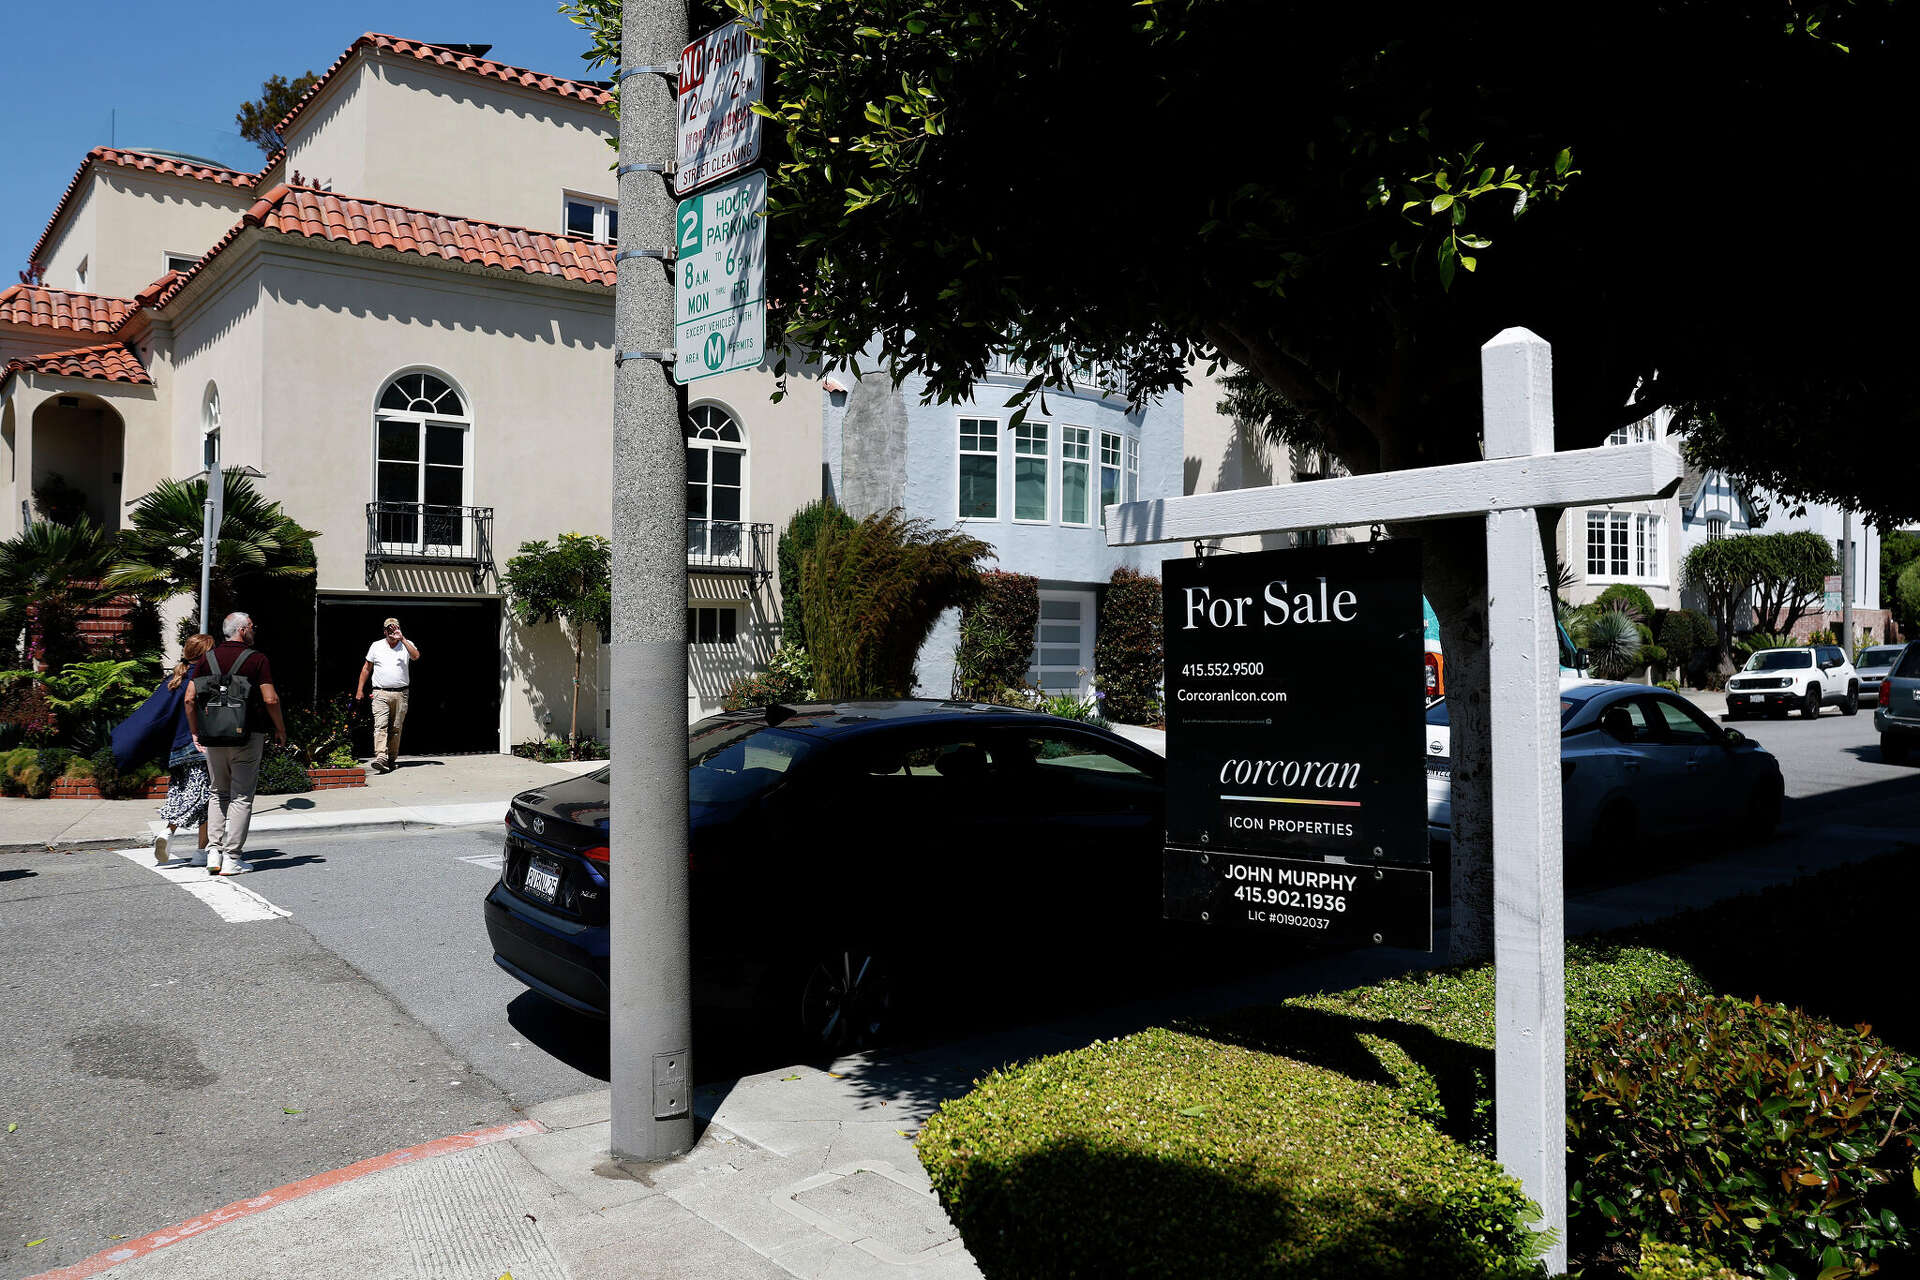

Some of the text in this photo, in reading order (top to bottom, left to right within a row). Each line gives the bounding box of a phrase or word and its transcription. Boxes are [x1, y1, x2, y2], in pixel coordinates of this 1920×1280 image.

[682, 44, 703, 89] NO
[683, 92, 698, 124] 12
[700, 98, 714, 114] NOON
[731, 71, 740, 100] 2
[683, 143, 752, 186] STREET CLEANING
[716, 189, 749, 218] HOUR
[681, 210, 698, 249] 2
[706, 211, 759, 247] PARKING
[685, 262, 694, 290] 8
[715, 251, 722, 262] TO
[726, 247, 735, 276] 6
[688, 292, 709, 316] MON
[733, 278, 749, 301] FRI
[685, 310, 752, 339] EXCEPT VEHICLES WITH
[685, 353, 699, 365] AREA
[707, 335, 722, 367] M
[728, 338, 754, 353] PERMITS
[1182, 576, 1358, 630] For Sale
[1182, 661, 1264, 677] 415.552.9500
[1177, 689, 1287, 702] CorcoranIcon.com
[1219, 759, 1361, 789] corcoran
[1229, 816, 1353, 836] ICON PROPERTIES
[1224, 864, 1357, 892] JOHN MURPHY
[1234, 886, 1346, 912] 415.902.1936
[1248, 910, 1330, 930] LIC #01902037
